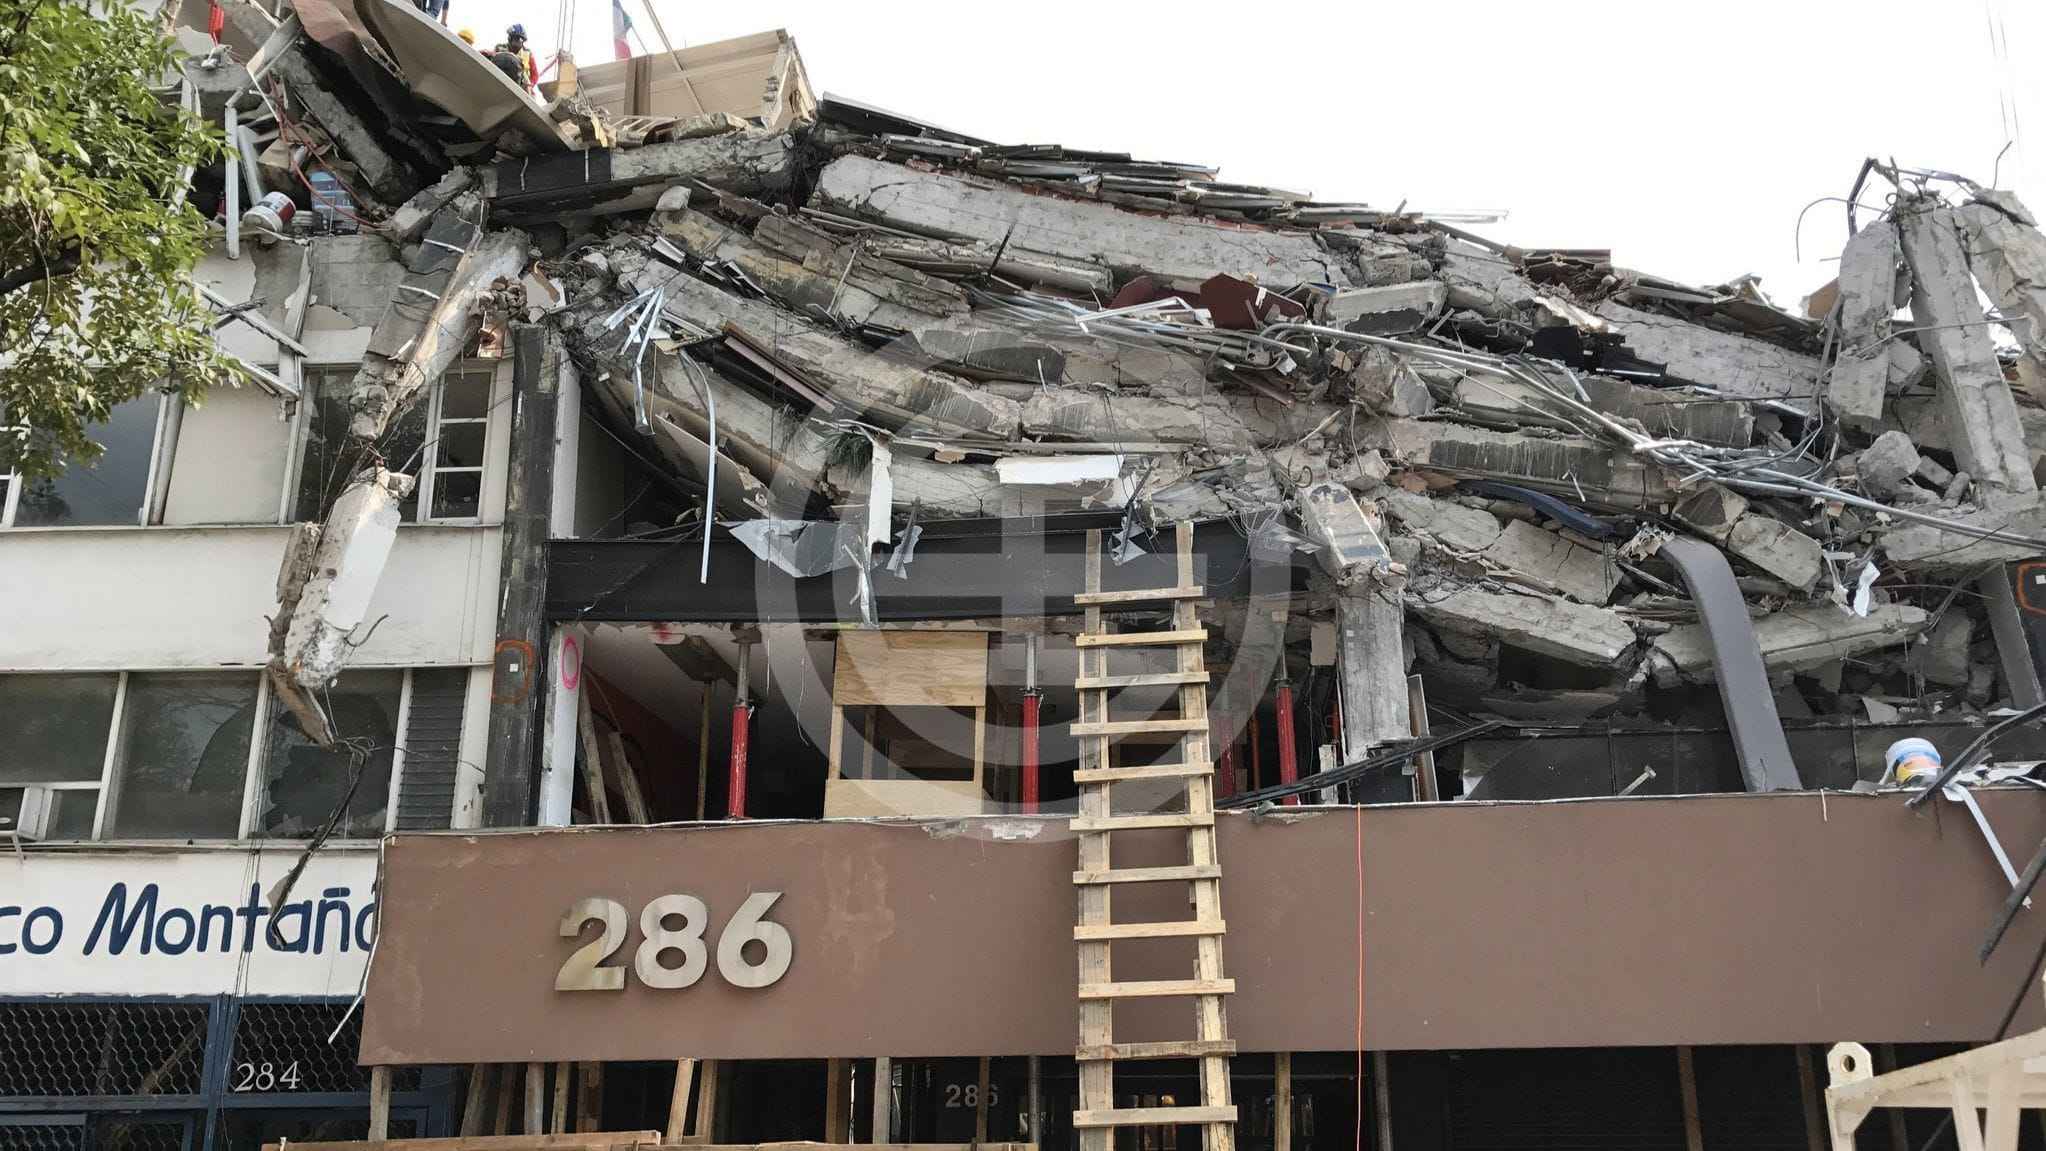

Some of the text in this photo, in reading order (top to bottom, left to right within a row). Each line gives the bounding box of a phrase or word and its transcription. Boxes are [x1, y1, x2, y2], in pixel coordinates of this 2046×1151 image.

[555, 892, 794, 991] 286
[235, 1061, 301, 1091] 284
[945, 1083, 999, 1108] 286
